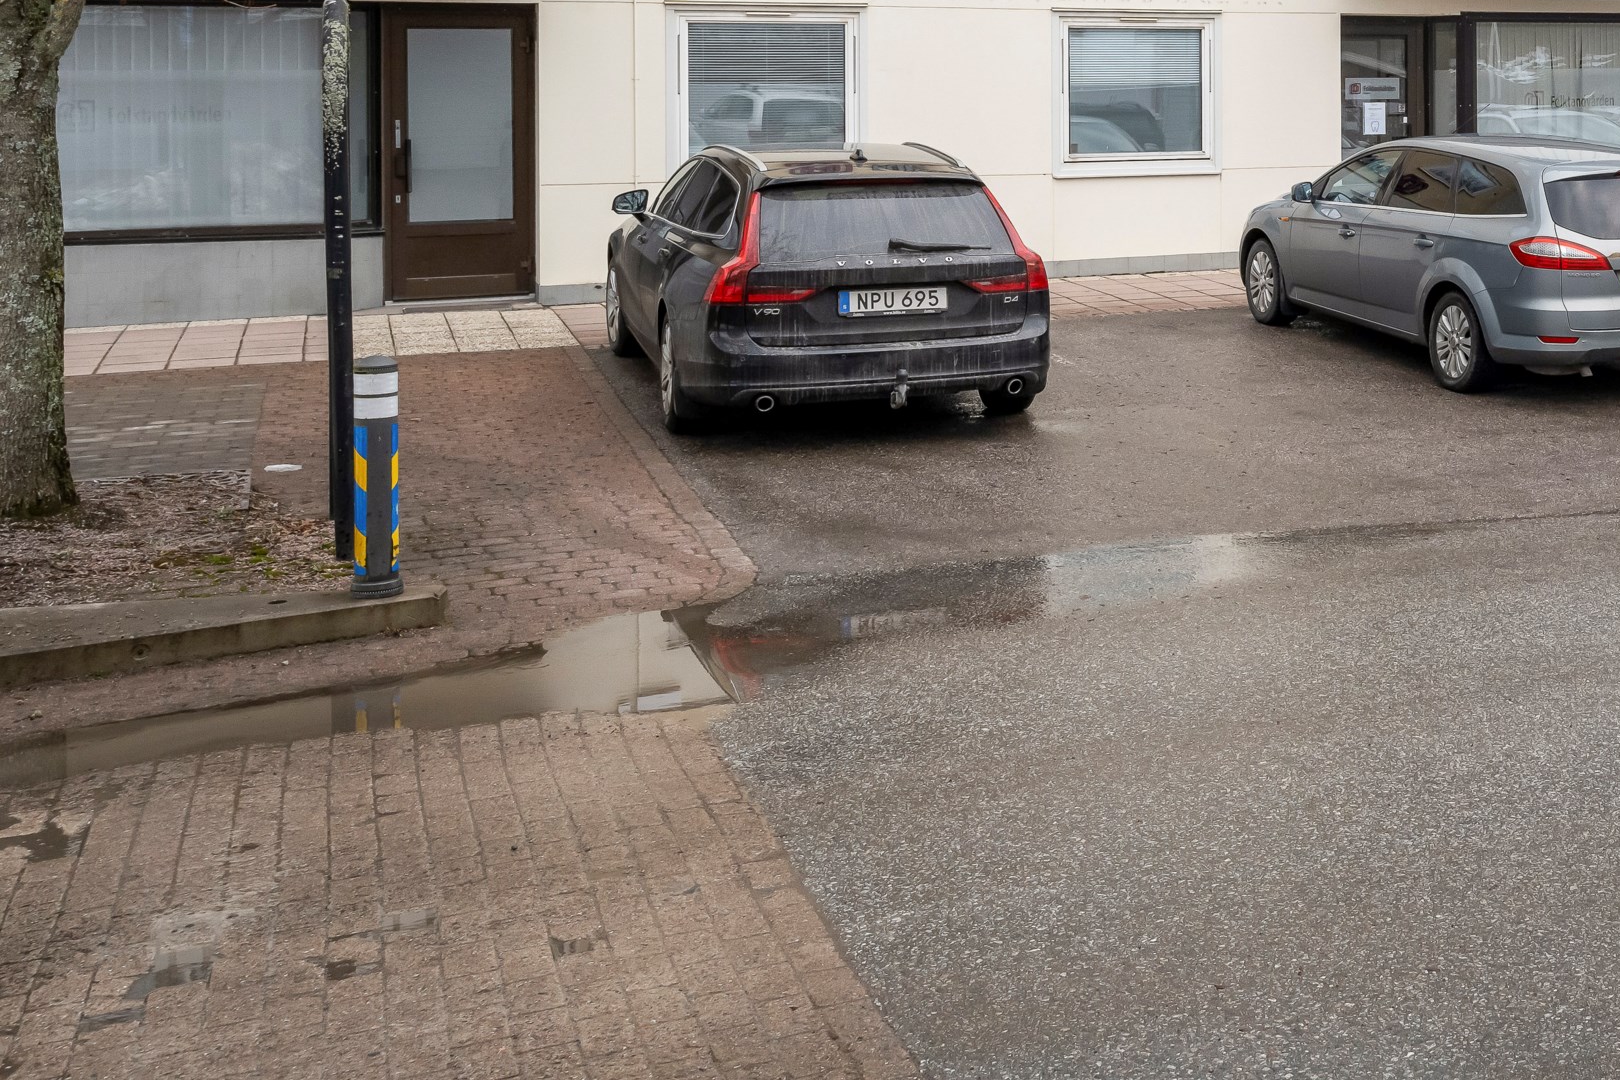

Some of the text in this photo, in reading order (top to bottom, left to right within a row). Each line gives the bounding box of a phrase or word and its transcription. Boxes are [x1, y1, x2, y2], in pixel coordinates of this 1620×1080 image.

[836, 256, 954, 267] VOLVO
[857, 290, 939, 310] NPU 695
[1004, 295, 1019, 303] D4
[753, 308, 781, 316] V90
